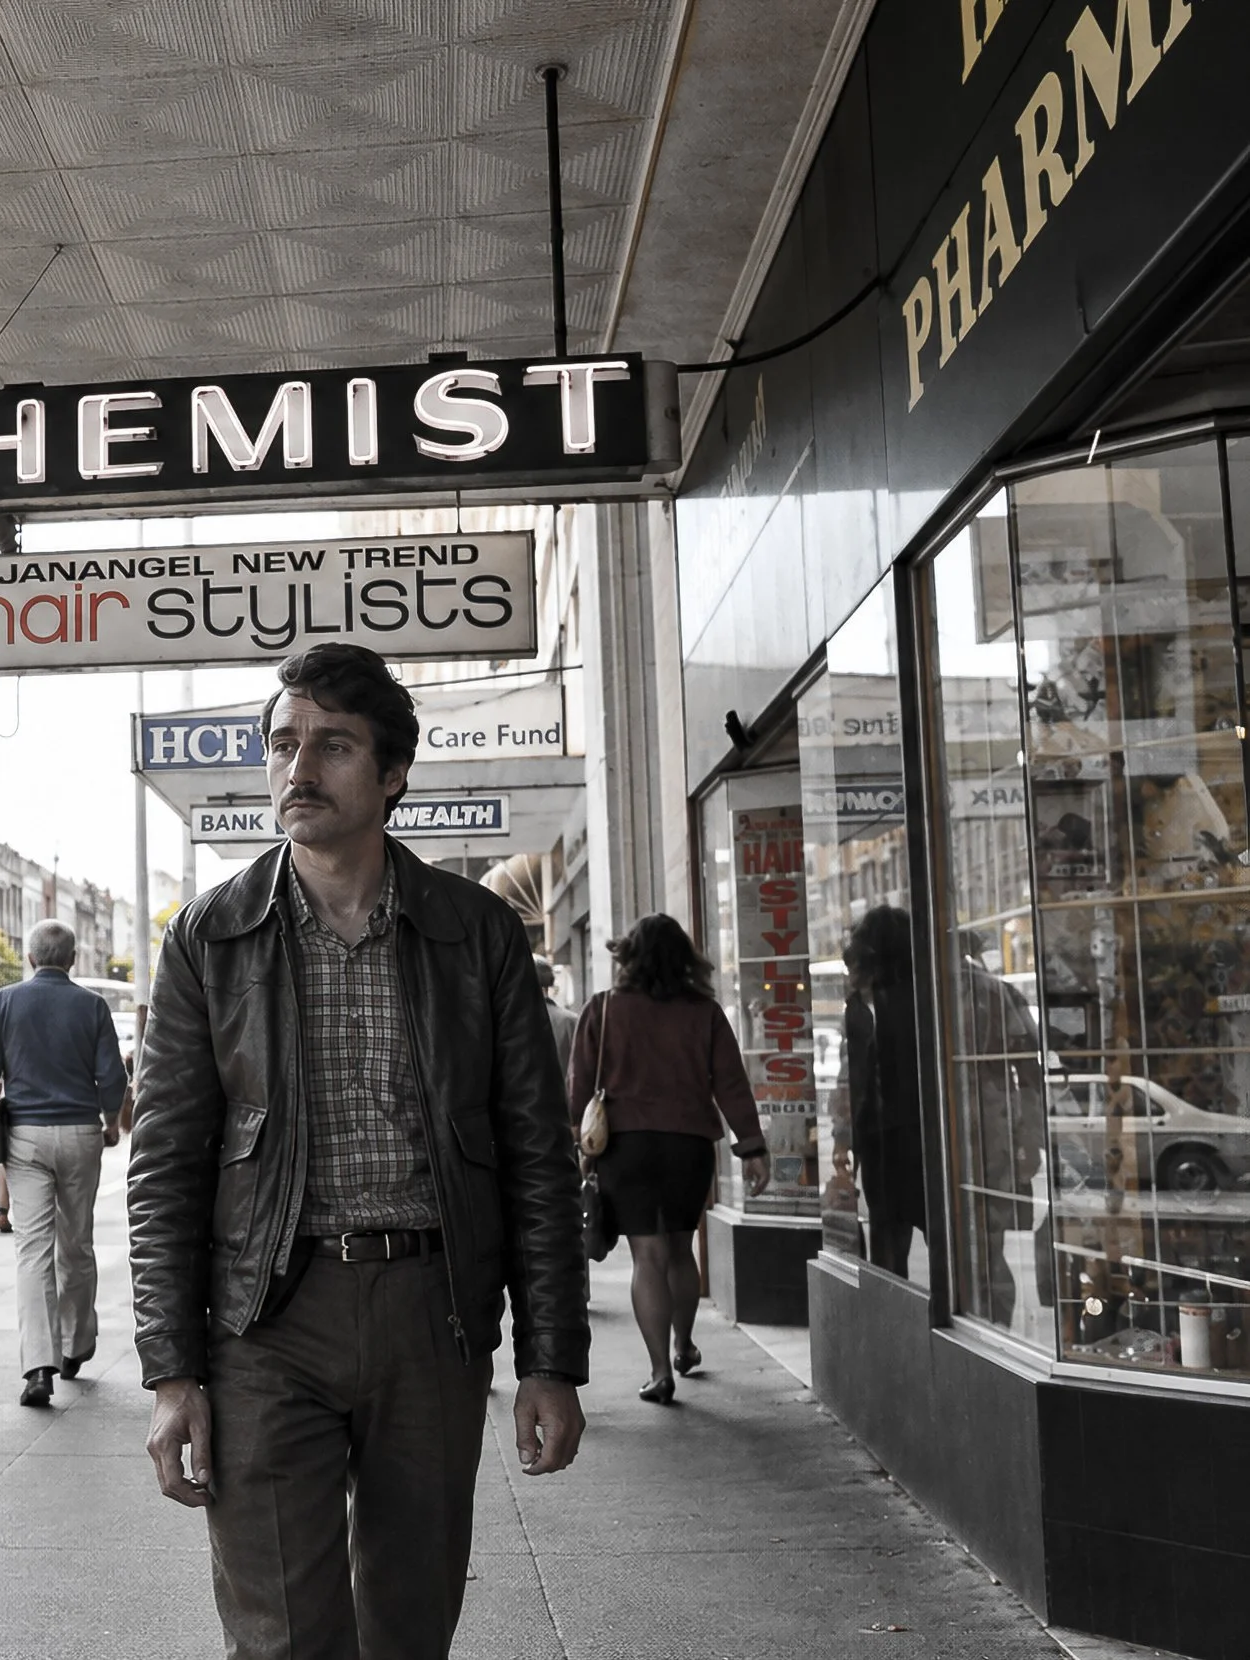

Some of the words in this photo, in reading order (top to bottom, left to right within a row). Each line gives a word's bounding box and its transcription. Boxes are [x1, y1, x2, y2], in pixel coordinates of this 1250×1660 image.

[232, 550, 326, 573] NEW
[339, 544, 480, 569] TREND
[427, 726, 487, 749] Care
[496, 722, 561, 746] Fund
[201, 813, 264, 832] BANK
[388, 804, 494, 828] WEALTH
